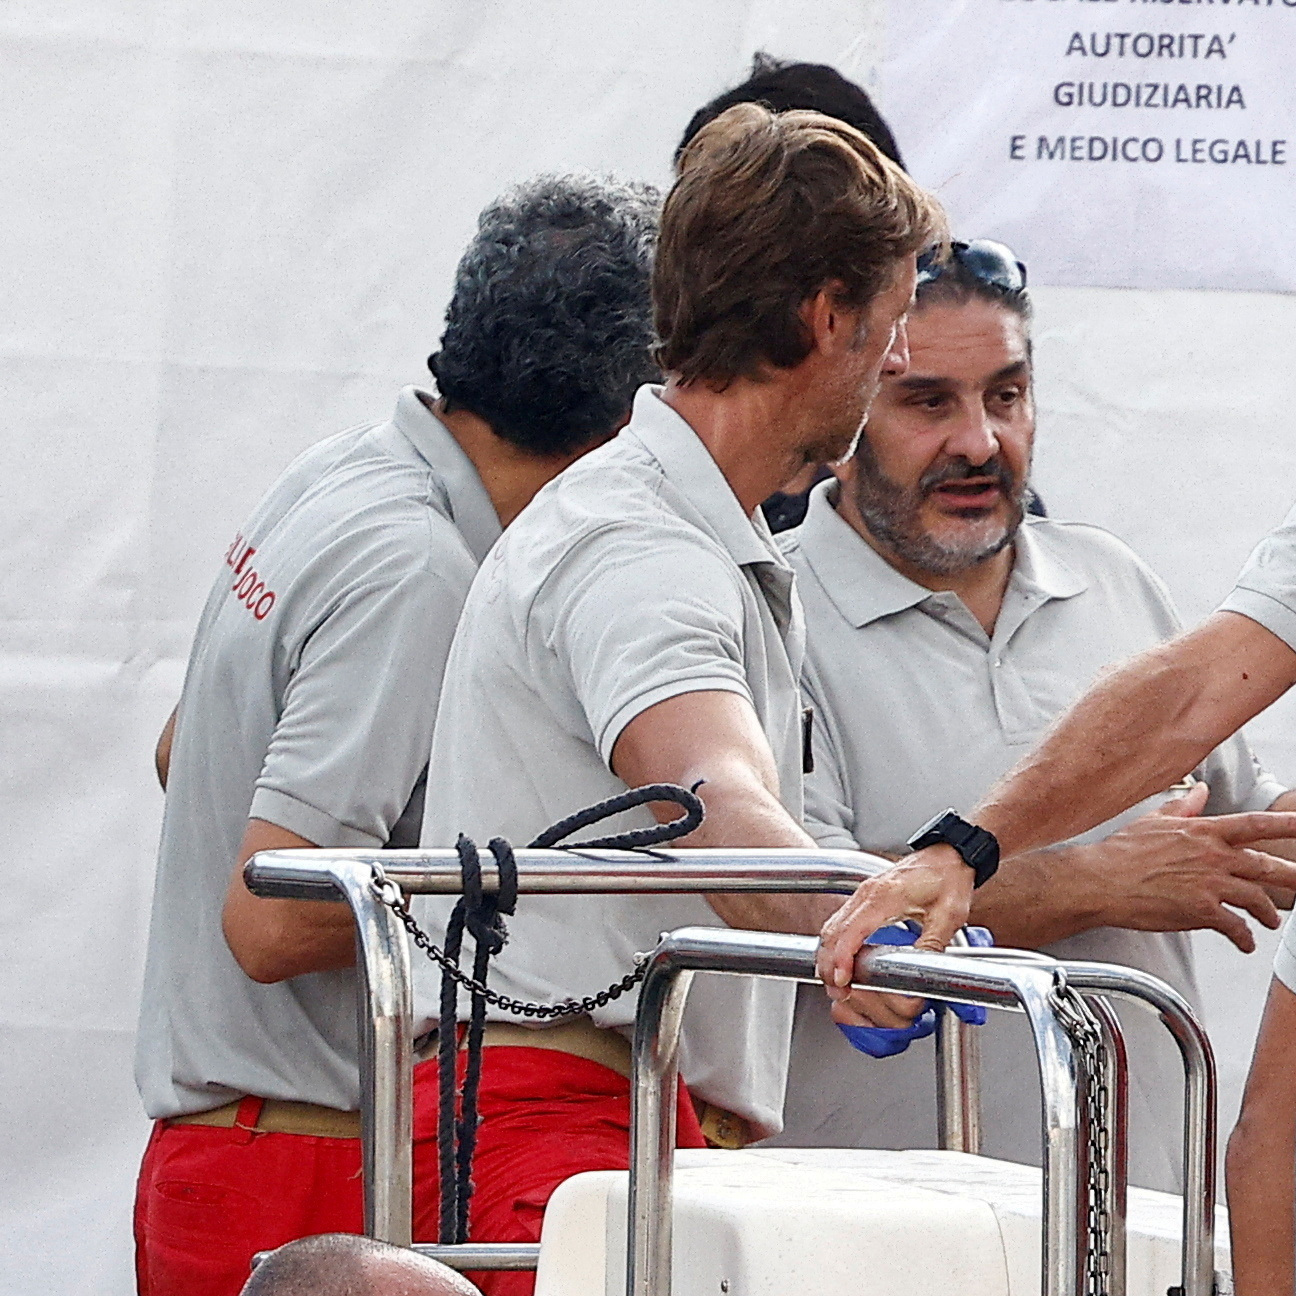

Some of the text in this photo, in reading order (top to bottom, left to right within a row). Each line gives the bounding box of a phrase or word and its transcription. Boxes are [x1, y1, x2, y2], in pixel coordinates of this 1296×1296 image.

[1065, 31, 1237, 60] AUTORITA'
[1053, 81, 1247, 110] GIUDIZIARIA
[1010, 135, 1288, 165] E MEDICO LEGALE
